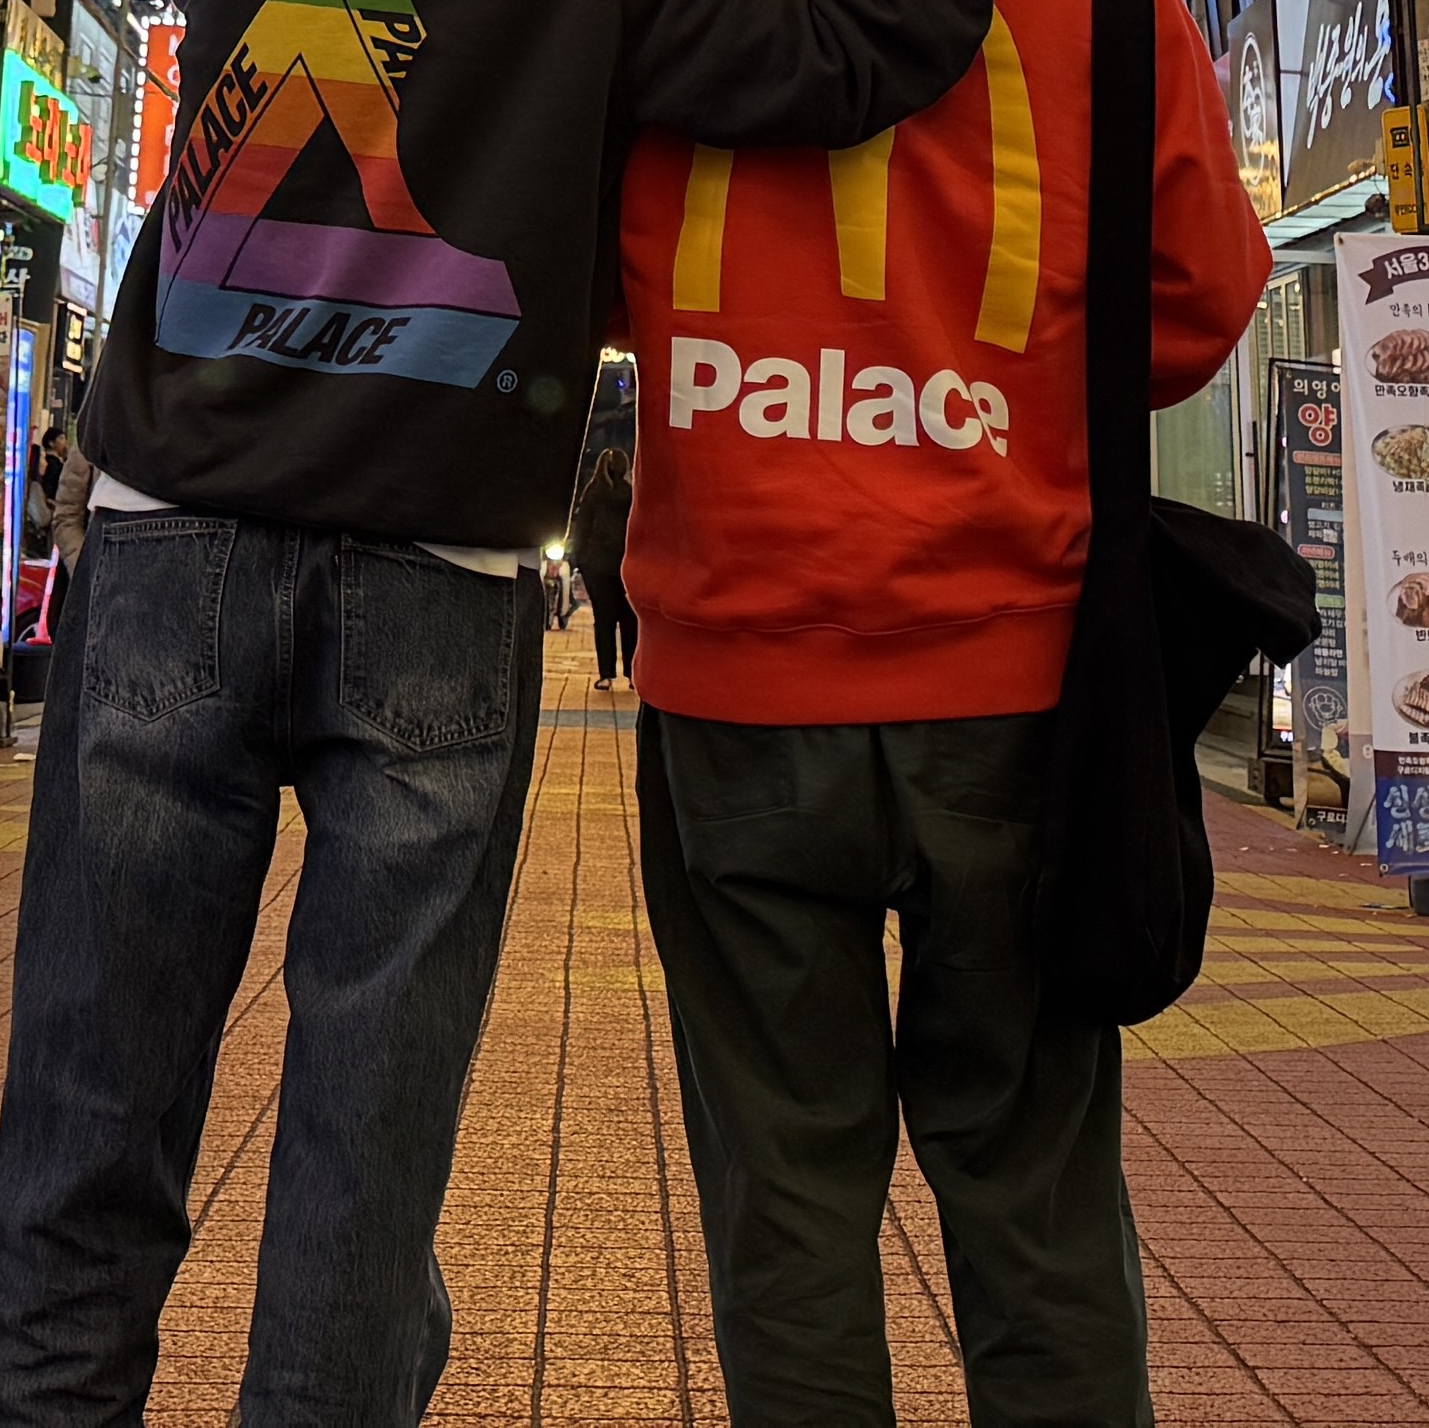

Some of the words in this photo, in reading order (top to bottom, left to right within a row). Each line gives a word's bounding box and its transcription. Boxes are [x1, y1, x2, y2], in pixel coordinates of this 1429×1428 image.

[166, 42, 270, 253] PALACE
[226, 302, 413, 367] PALACE
[668, 336, 1010, 460] Palace
